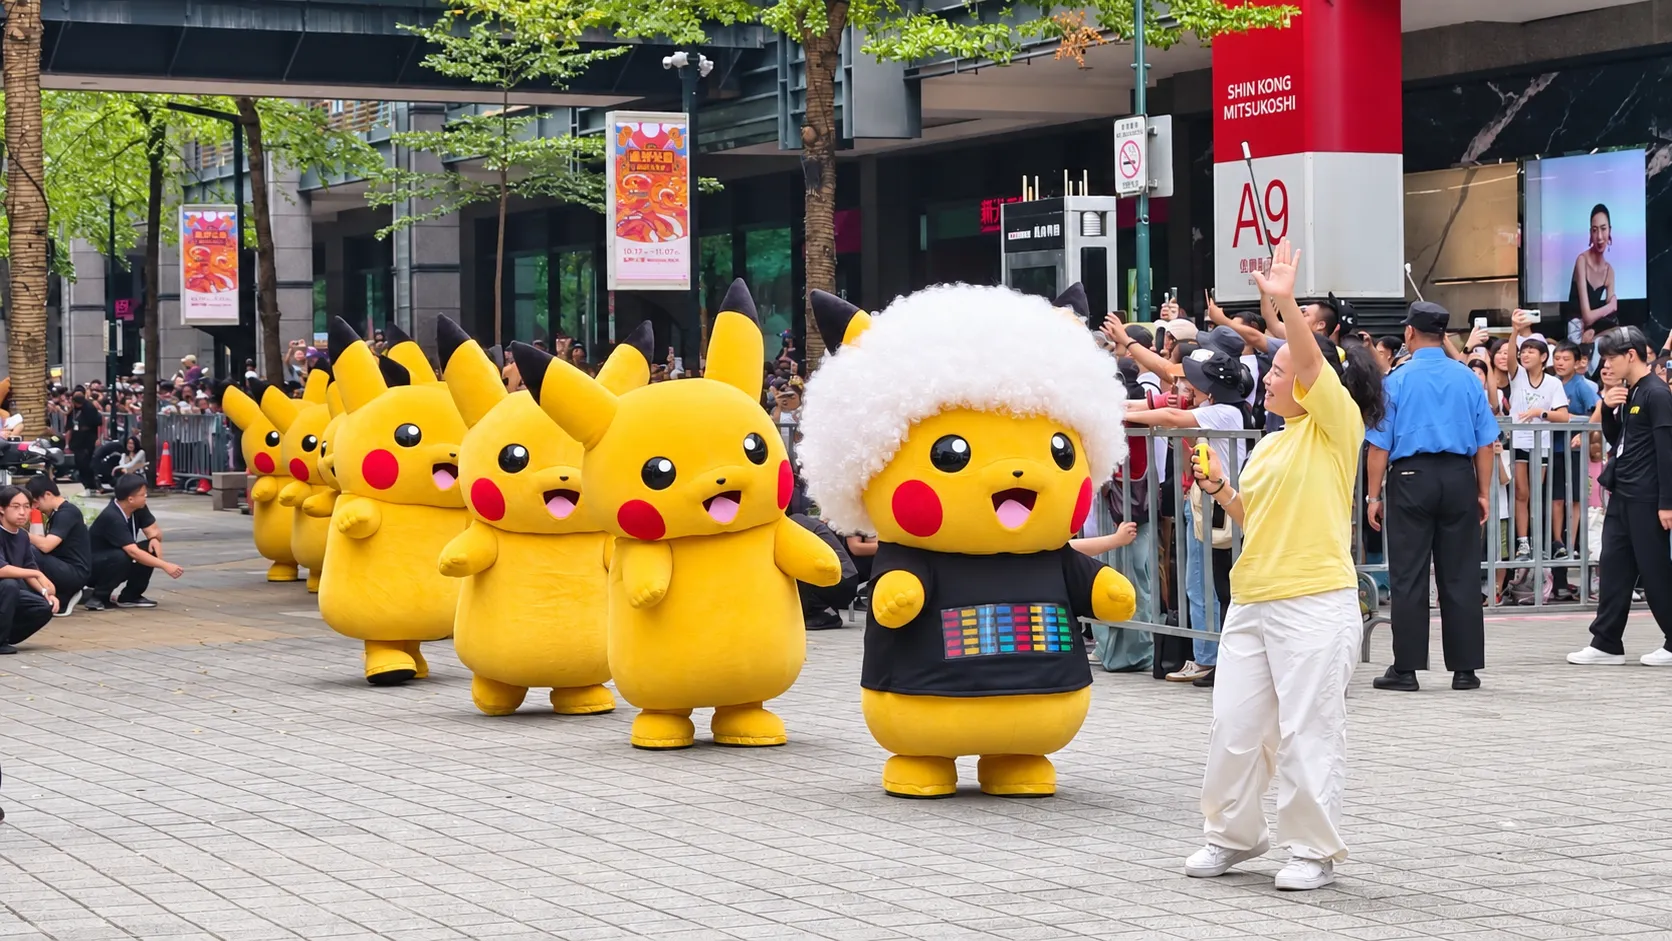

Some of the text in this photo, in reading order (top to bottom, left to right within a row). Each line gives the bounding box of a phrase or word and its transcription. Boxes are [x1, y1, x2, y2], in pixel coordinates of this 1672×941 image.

[1227, 75, 1292, 100] SHIN KONG
[1223, 95, 1296, 120] MITSUKOSHI
[1232, 179, 1289, 248] A9
